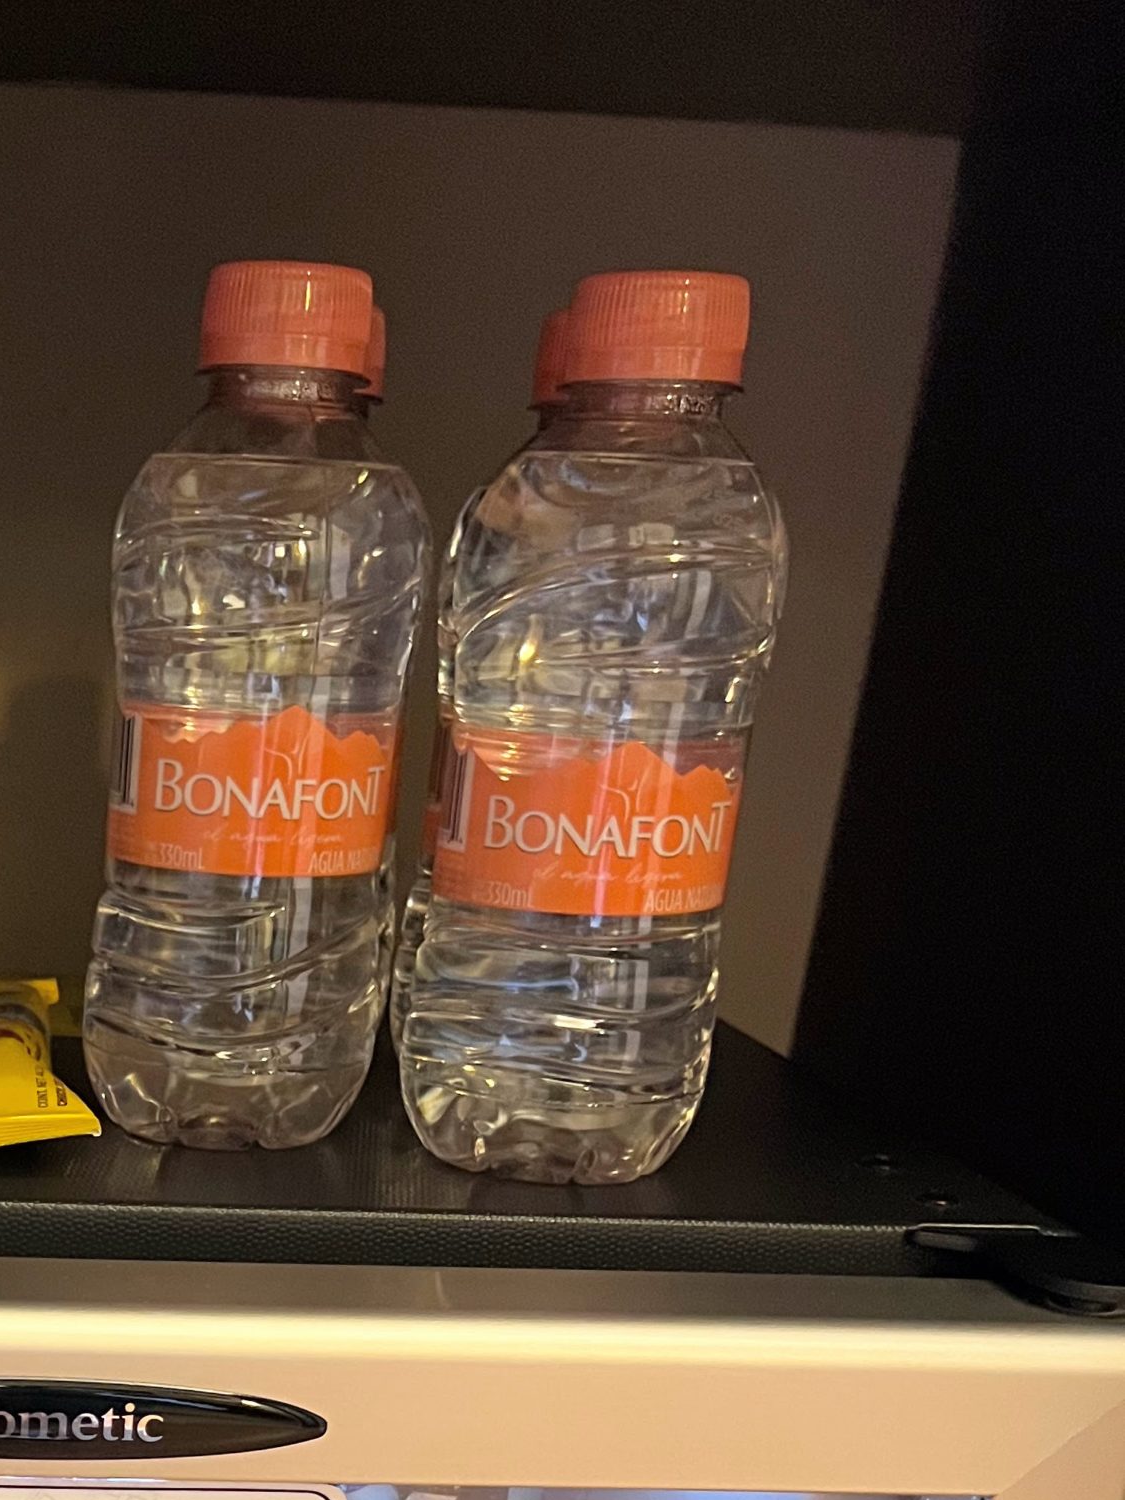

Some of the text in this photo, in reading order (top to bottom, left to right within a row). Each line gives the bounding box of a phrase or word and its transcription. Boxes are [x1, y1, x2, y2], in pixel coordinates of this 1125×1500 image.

[154, 758, 386, 821] BONAFONT
[483, 795, 732, 858] BONAFONT
[307, 850, 346, 874] AGUA
[643, 889, 683, 913] AGUA
